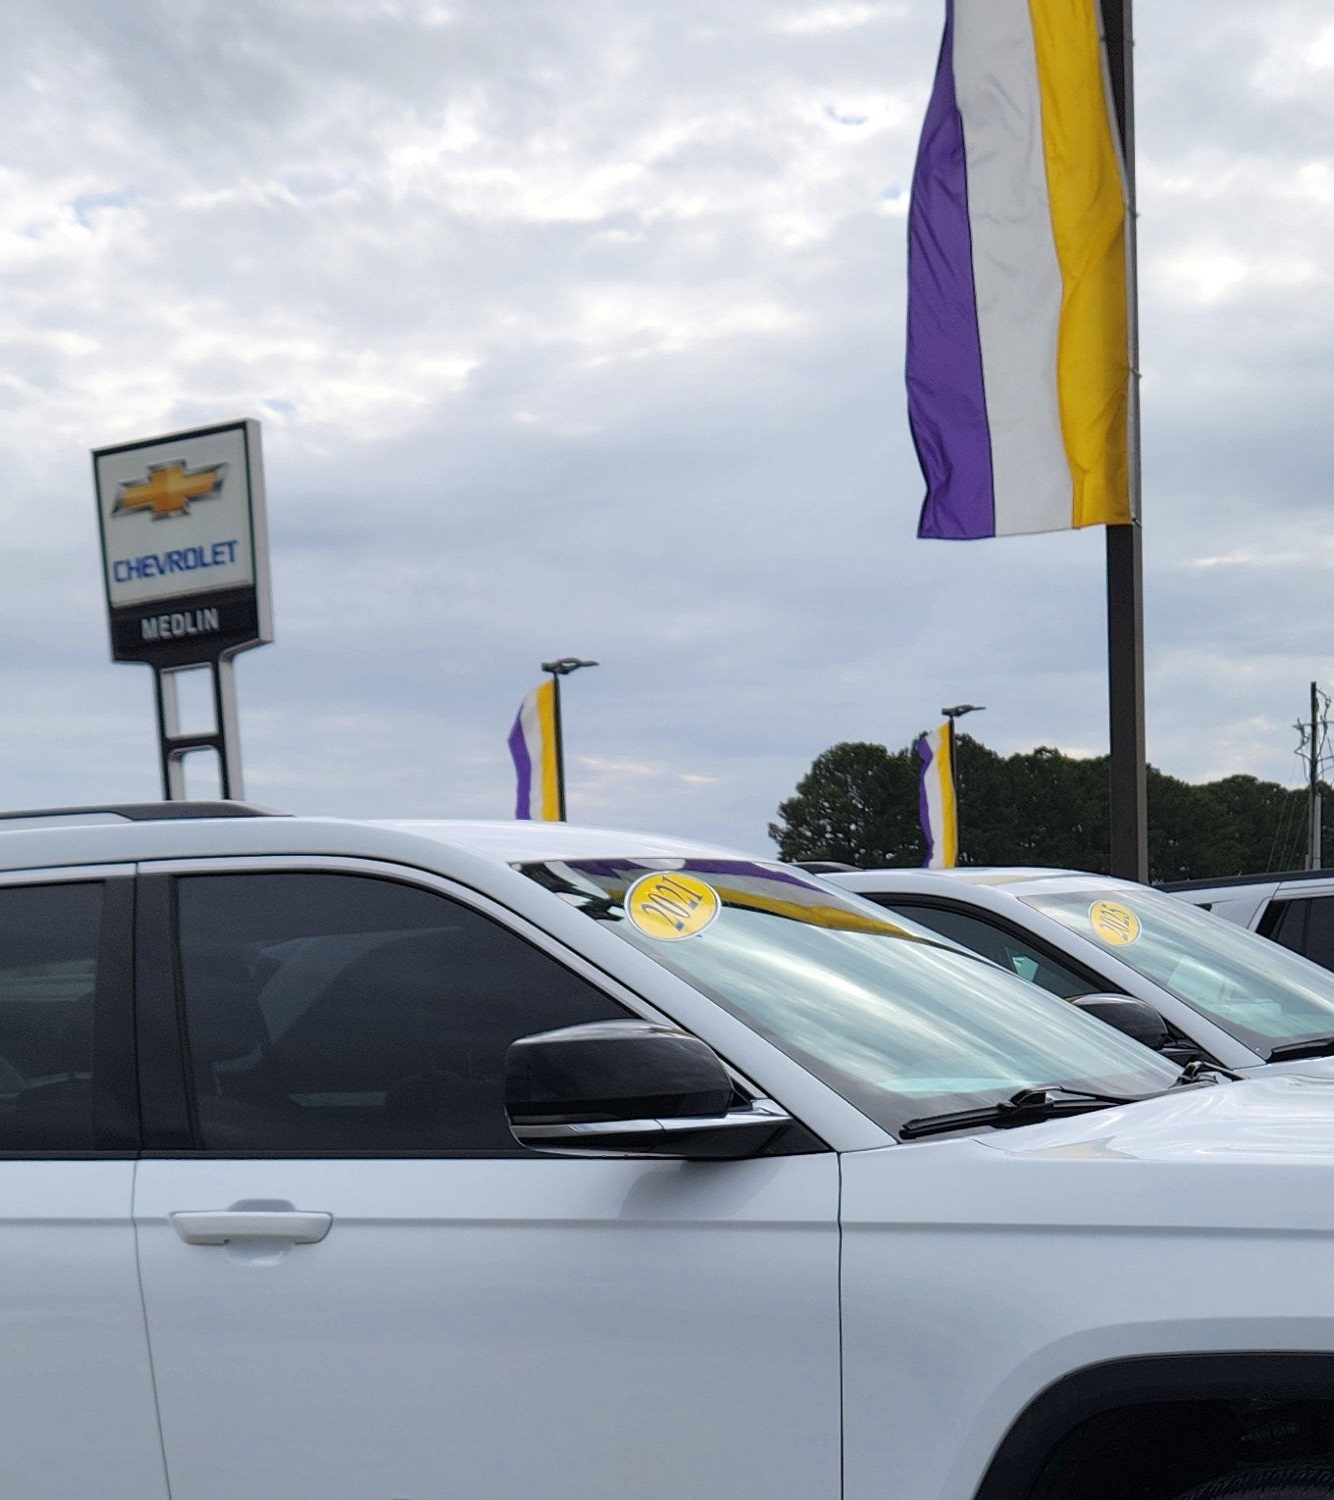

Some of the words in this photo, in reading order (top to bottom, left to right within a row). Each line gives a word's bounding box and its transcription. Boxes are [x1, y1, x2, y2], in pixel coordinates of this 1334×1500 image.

[113, 540, 237, 582] CHEVROLET
[141, 608, 219, 640] MEDLIN
[641, 875, 703, 932] 2021
